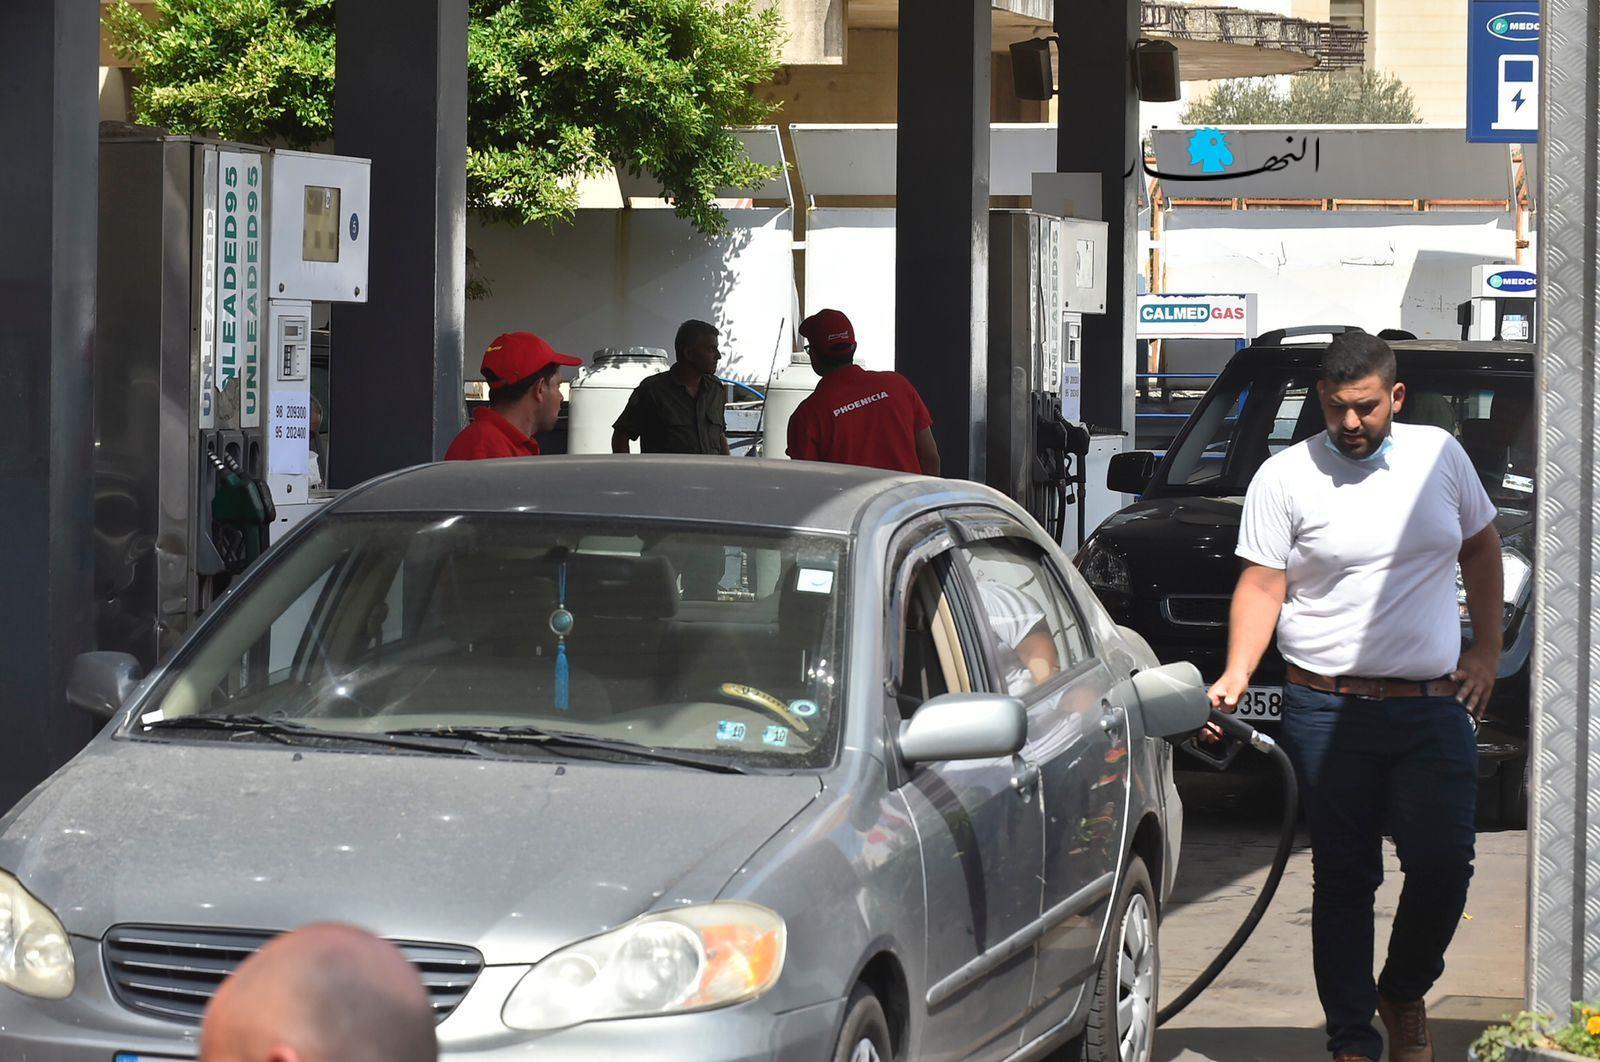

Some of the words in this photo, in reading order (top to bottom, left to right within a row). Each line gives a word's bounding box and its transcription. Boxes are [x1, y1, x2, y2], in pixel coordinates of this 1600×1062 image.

[1509, 22, 1540, 31] MEDC
[221, 166, 238, 392] NLEADED95
[1502, 278, 1537, 286] MEDC
[246, 166, 259, 415] UNLEADED95
[1141, 307, 1208, 321] CALMED
[1211, 307, 1245, 320] GAS
[833, 391, 889, 417] PHOENICIA
[275, 425, 282, 439] 95
[1231, 692, 1282, 717] 358
